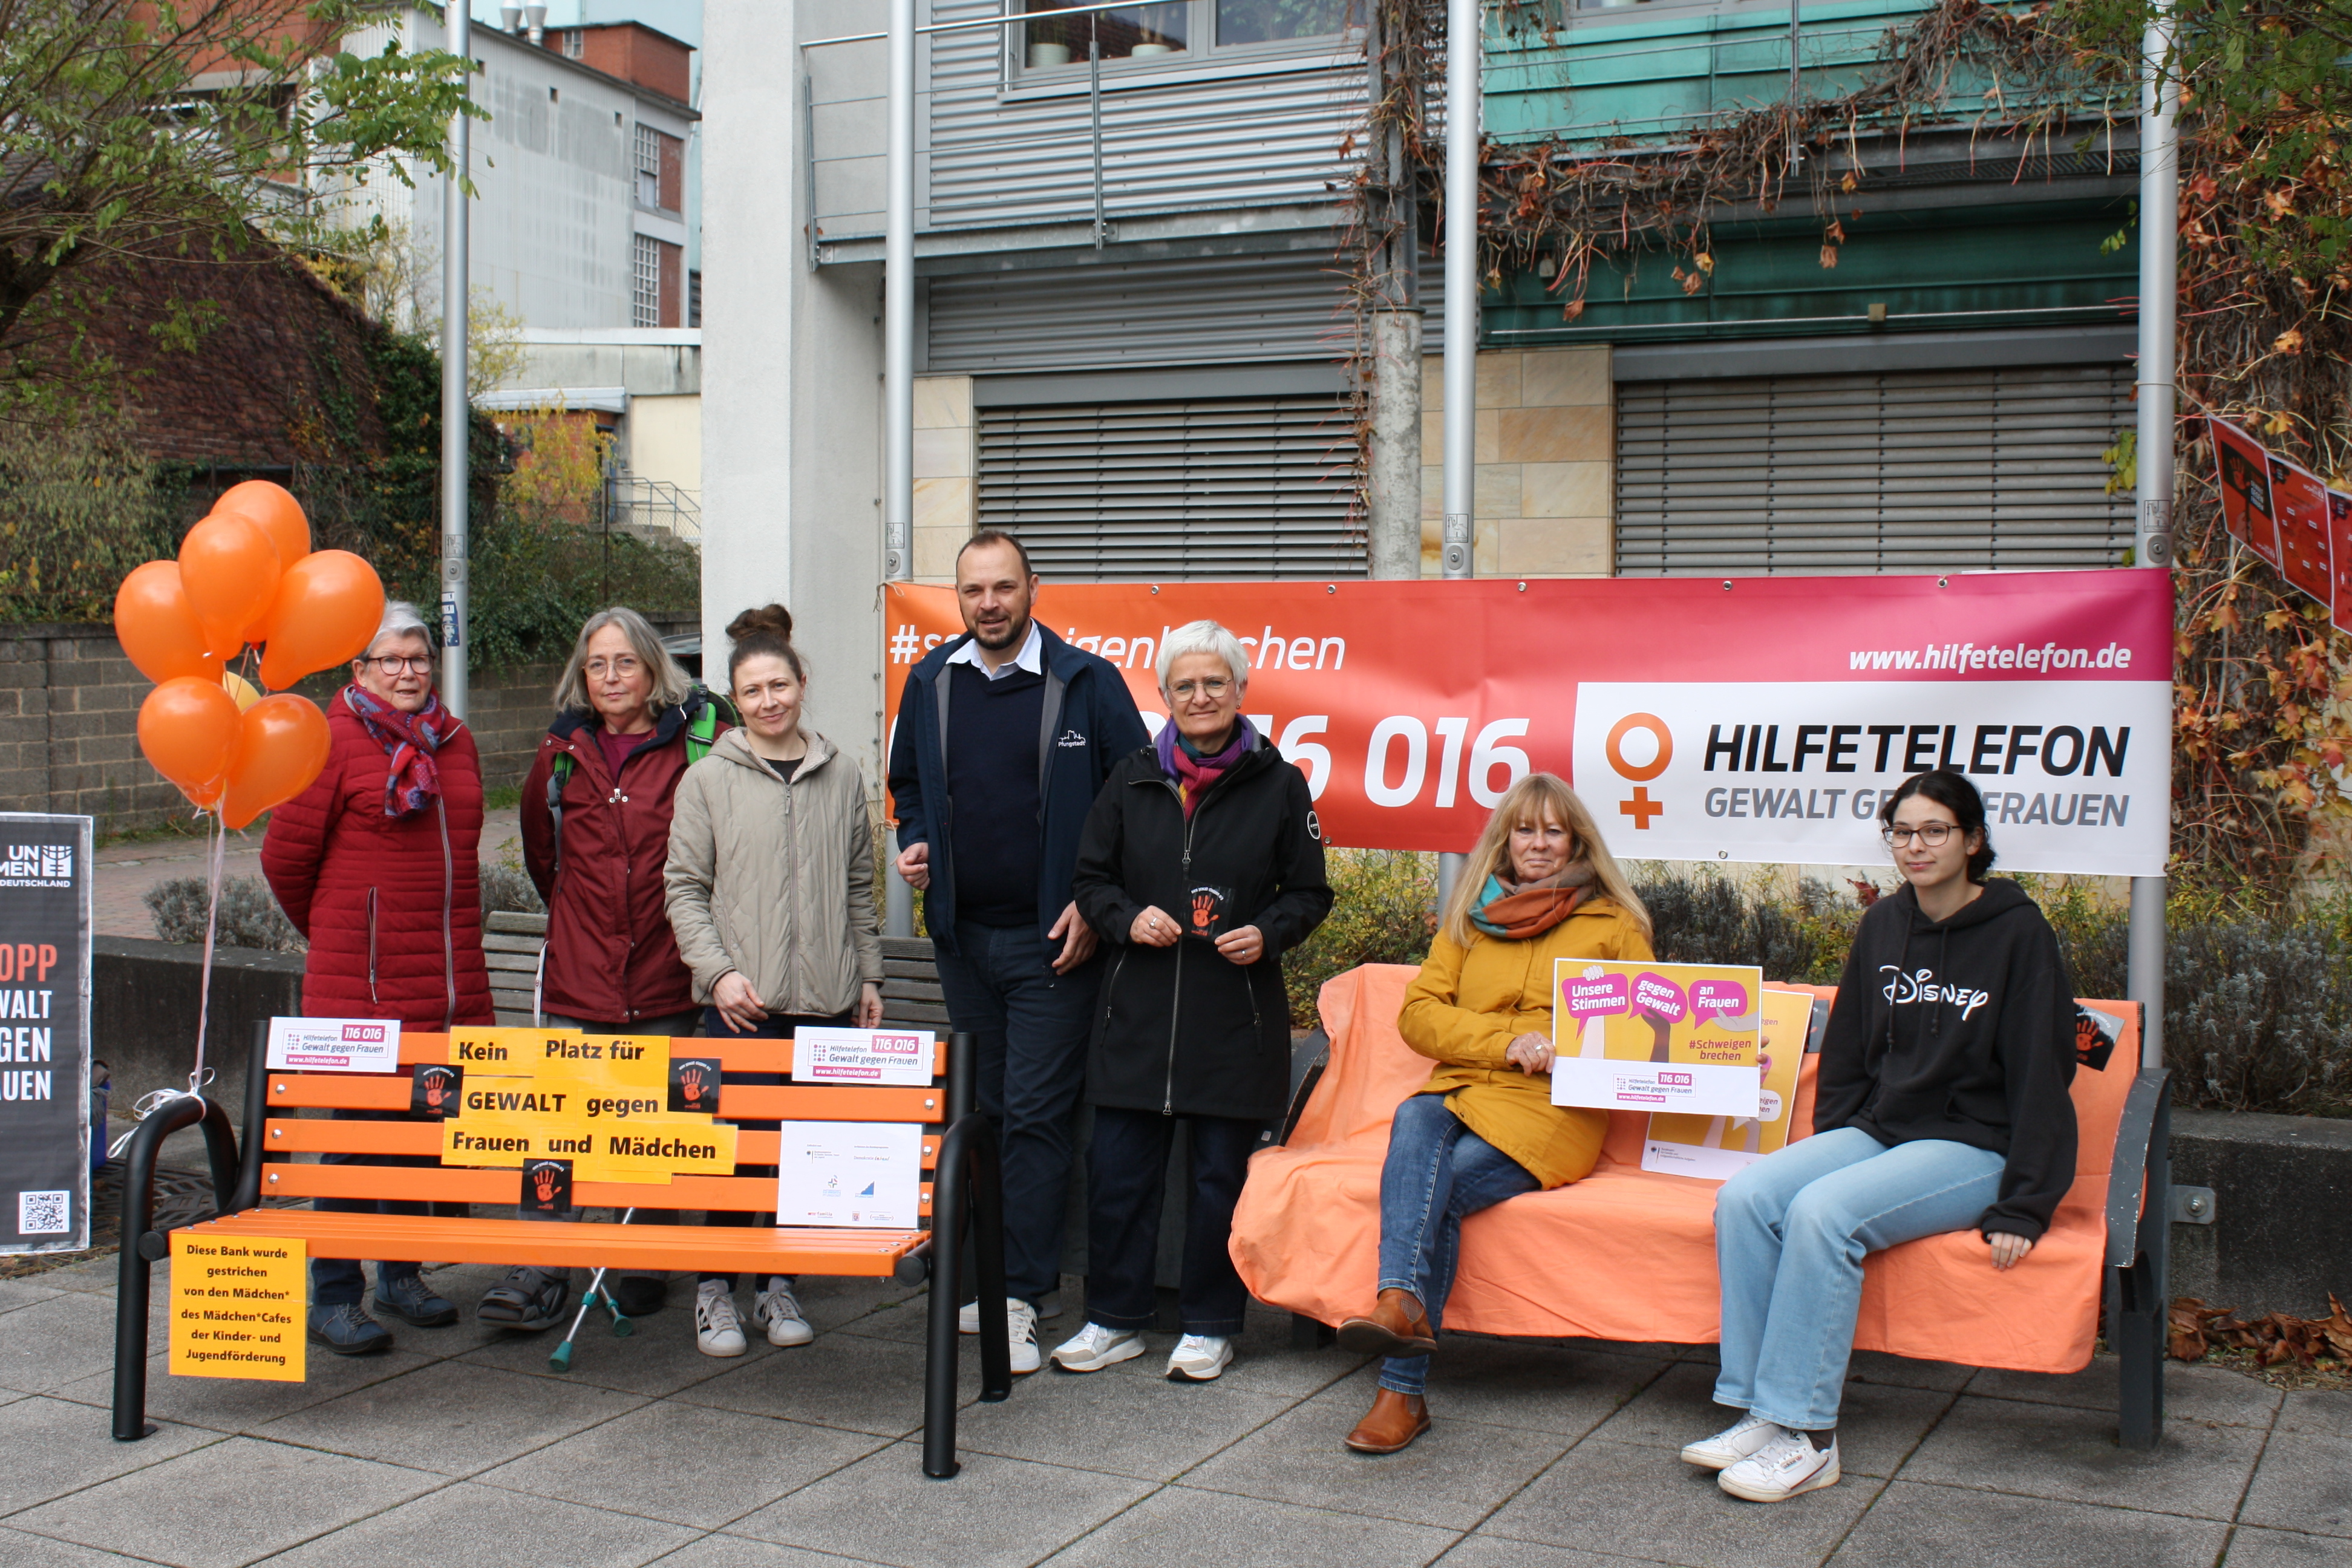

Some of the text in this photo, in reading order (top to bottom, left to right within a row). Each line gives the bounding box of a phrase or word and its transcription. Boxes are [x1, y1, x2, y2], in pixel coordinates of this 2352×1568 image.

[1850, 642, 2131, 673] www.hilfetelefon.de
[1704, 724, 2131, 777] HILFETELEFON
[1364, 715, 1530, 809] 016
[1704, 788, 1846, 819] GEWALT
[1981, 791, 2130, 827] FRAUEN
[8, 845, 39, 860] UN
[0, 879, 71, 887] DEUTSCHLAND
[1572, 984, 1613, 997] Unsere
[1638, 979, 1675, 999] gegen
[1699, 986, 1714, 995] an
[1571, 996, 1625, 1011] Stimmen
[1636, 991, 1681, 1016] Gewalt
[1697, 996, 1739, 1008] Frauen
[345, 1027, 382, 1039] 116 016
[302, 1043, 384, 1053] Gewalt gegen Frauen
[459, 1040, 645, 1060] Kein Platz für
[875, 1038, 915, 1051] 116 016
[1689, 1039, 1751, 1050] #Schweigen
[829, 1054, 918, 1065] Gewalt gegen Frauen
[1700, 1051, 1741, 1060] brechen
[815, 1068, 878, 1077] www.hilfetelefon.de
[1661, 1074, 1690, 1084] 116 016
[0, 1070, 51, 1101] UEN
[467, 1092, 658, 1117] GEWALT gegen
[452, 1132, 716, 1158] Frauen und Mädchen
[187, 1245, 288, 1258] Diese Bank wurde
[207, 1267, 267, 1278] gestrichen
[208, 1287, 229, 1297] den
[181, 1309, 200, 1319] des
[191, 1329, 281, 1343] der Kinder- und
[186, 1349, 286, 1366] Jugendförderung
